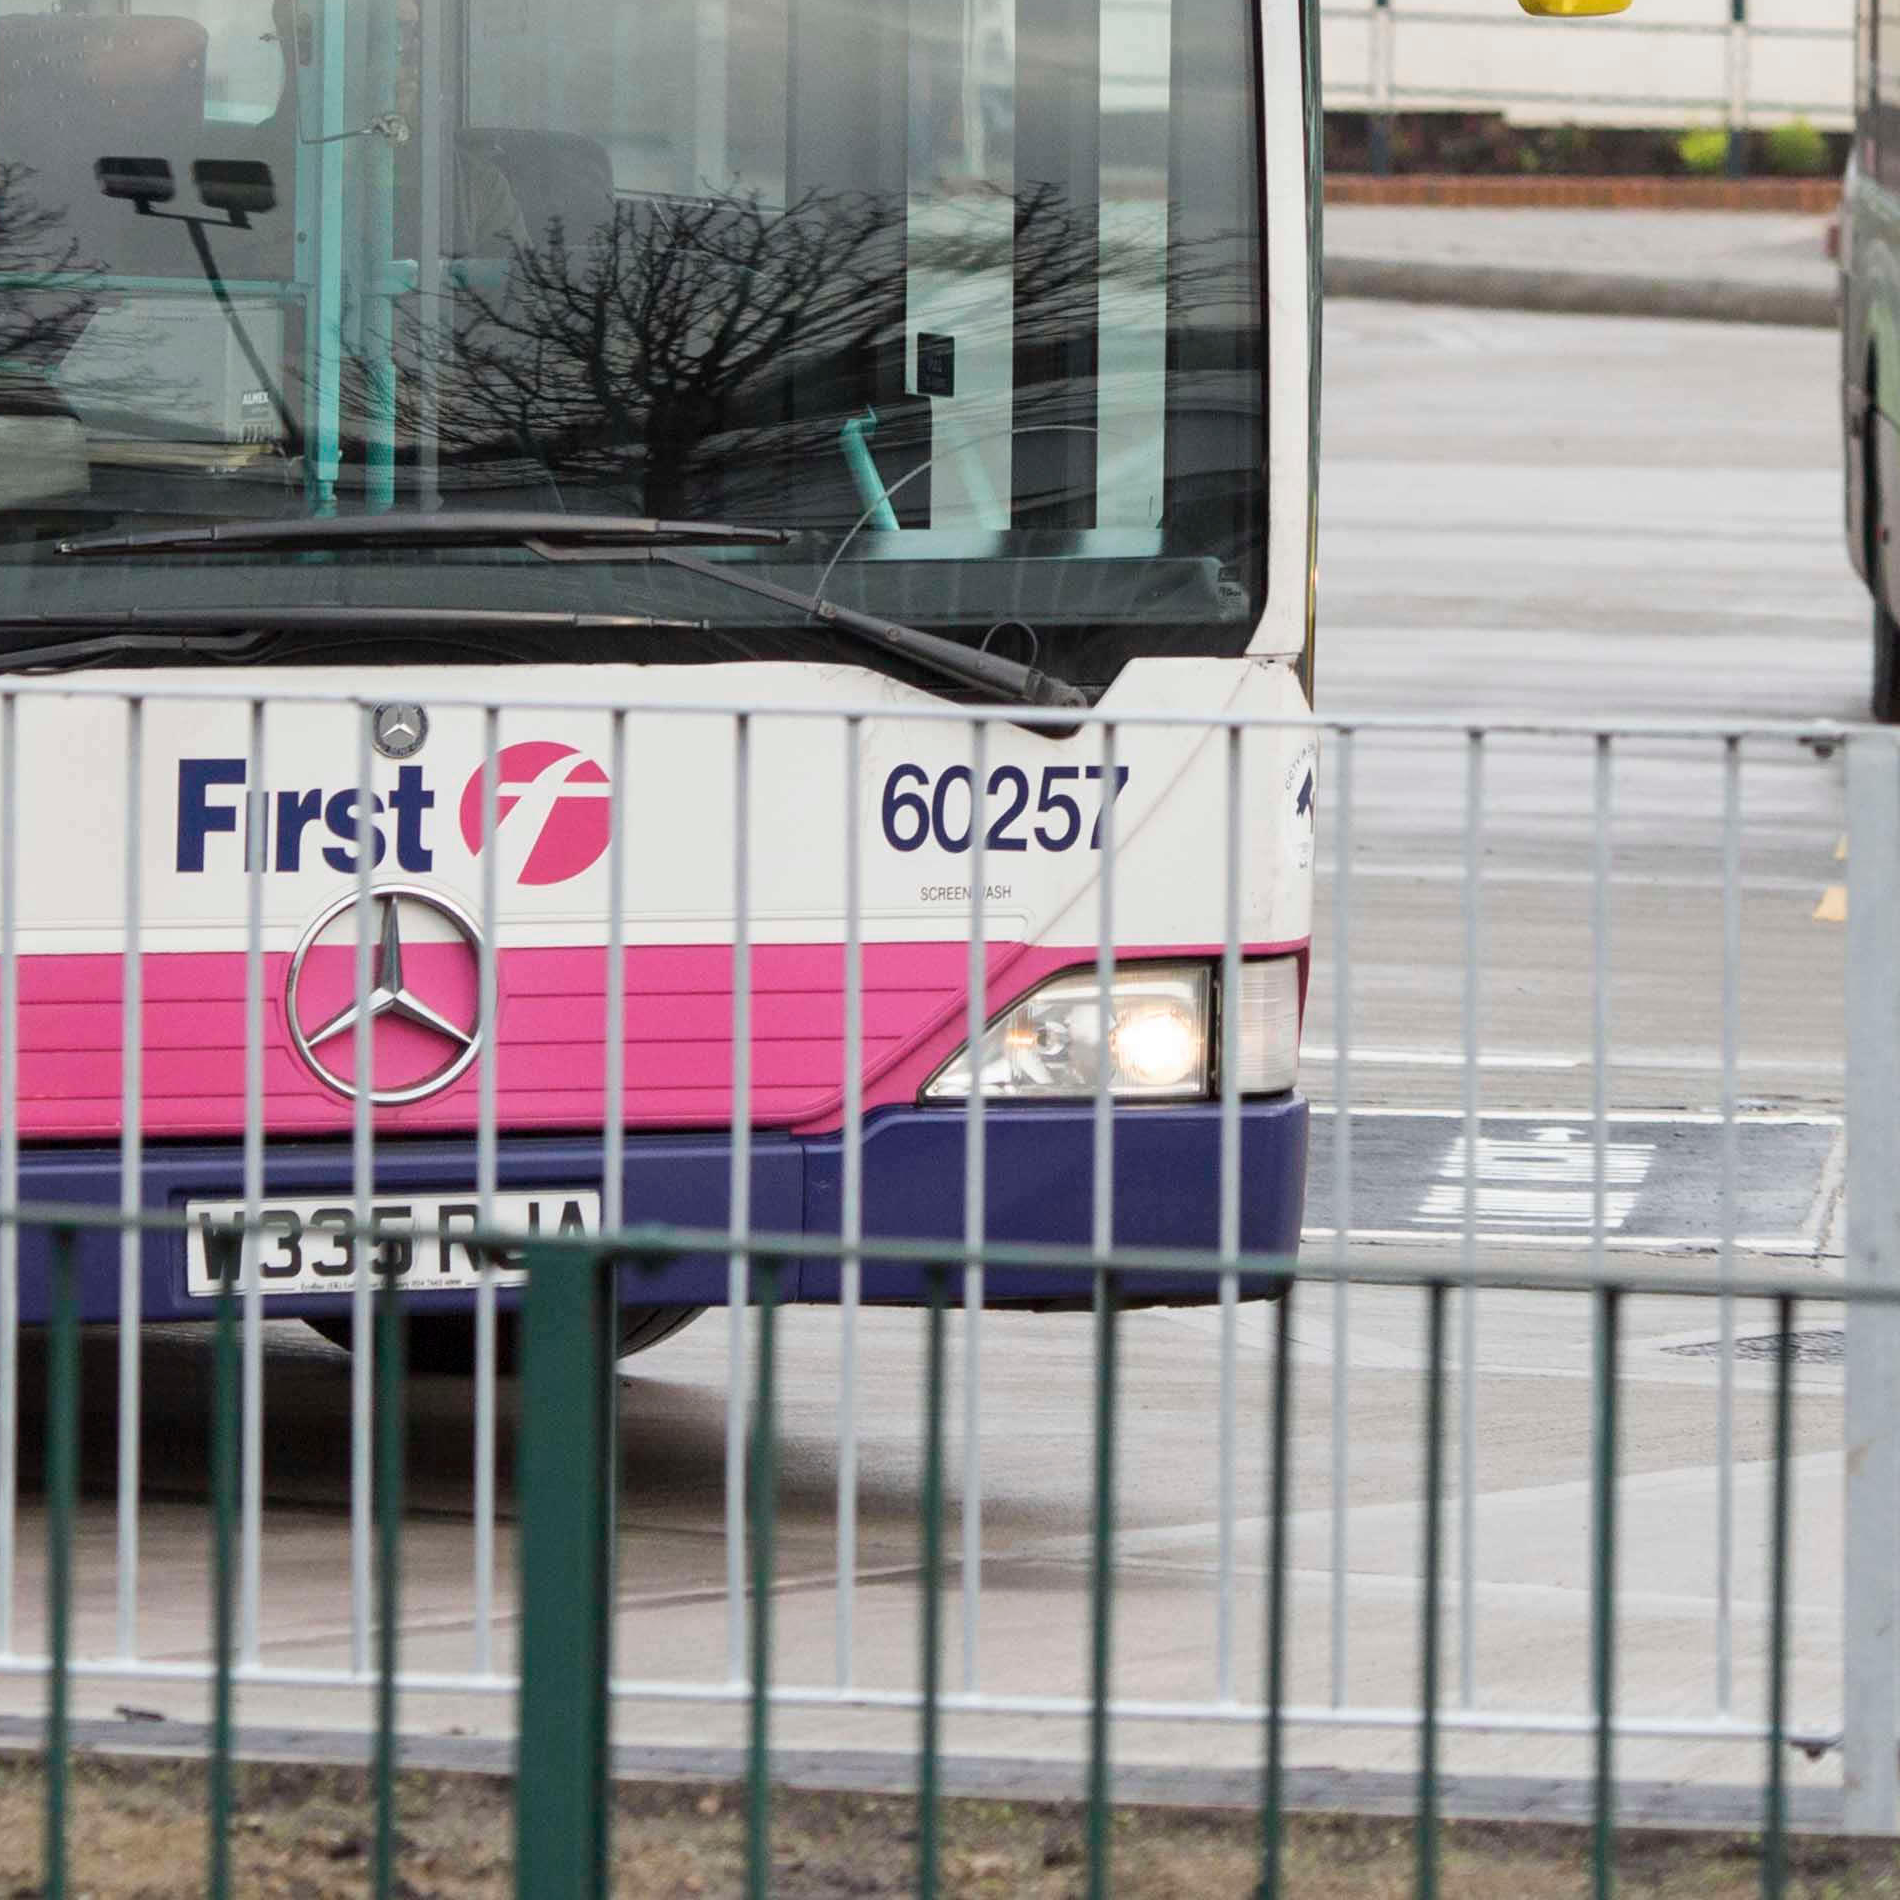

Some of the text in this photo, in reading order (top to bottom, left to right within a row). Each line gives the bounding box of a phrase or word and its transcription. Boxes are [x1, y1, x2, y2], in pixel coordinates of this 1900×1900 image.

[176, 759, 434, 873] First
[881, 763, 1129, 853] 60257
[920, 885, 1012, 901] SCREENASH
